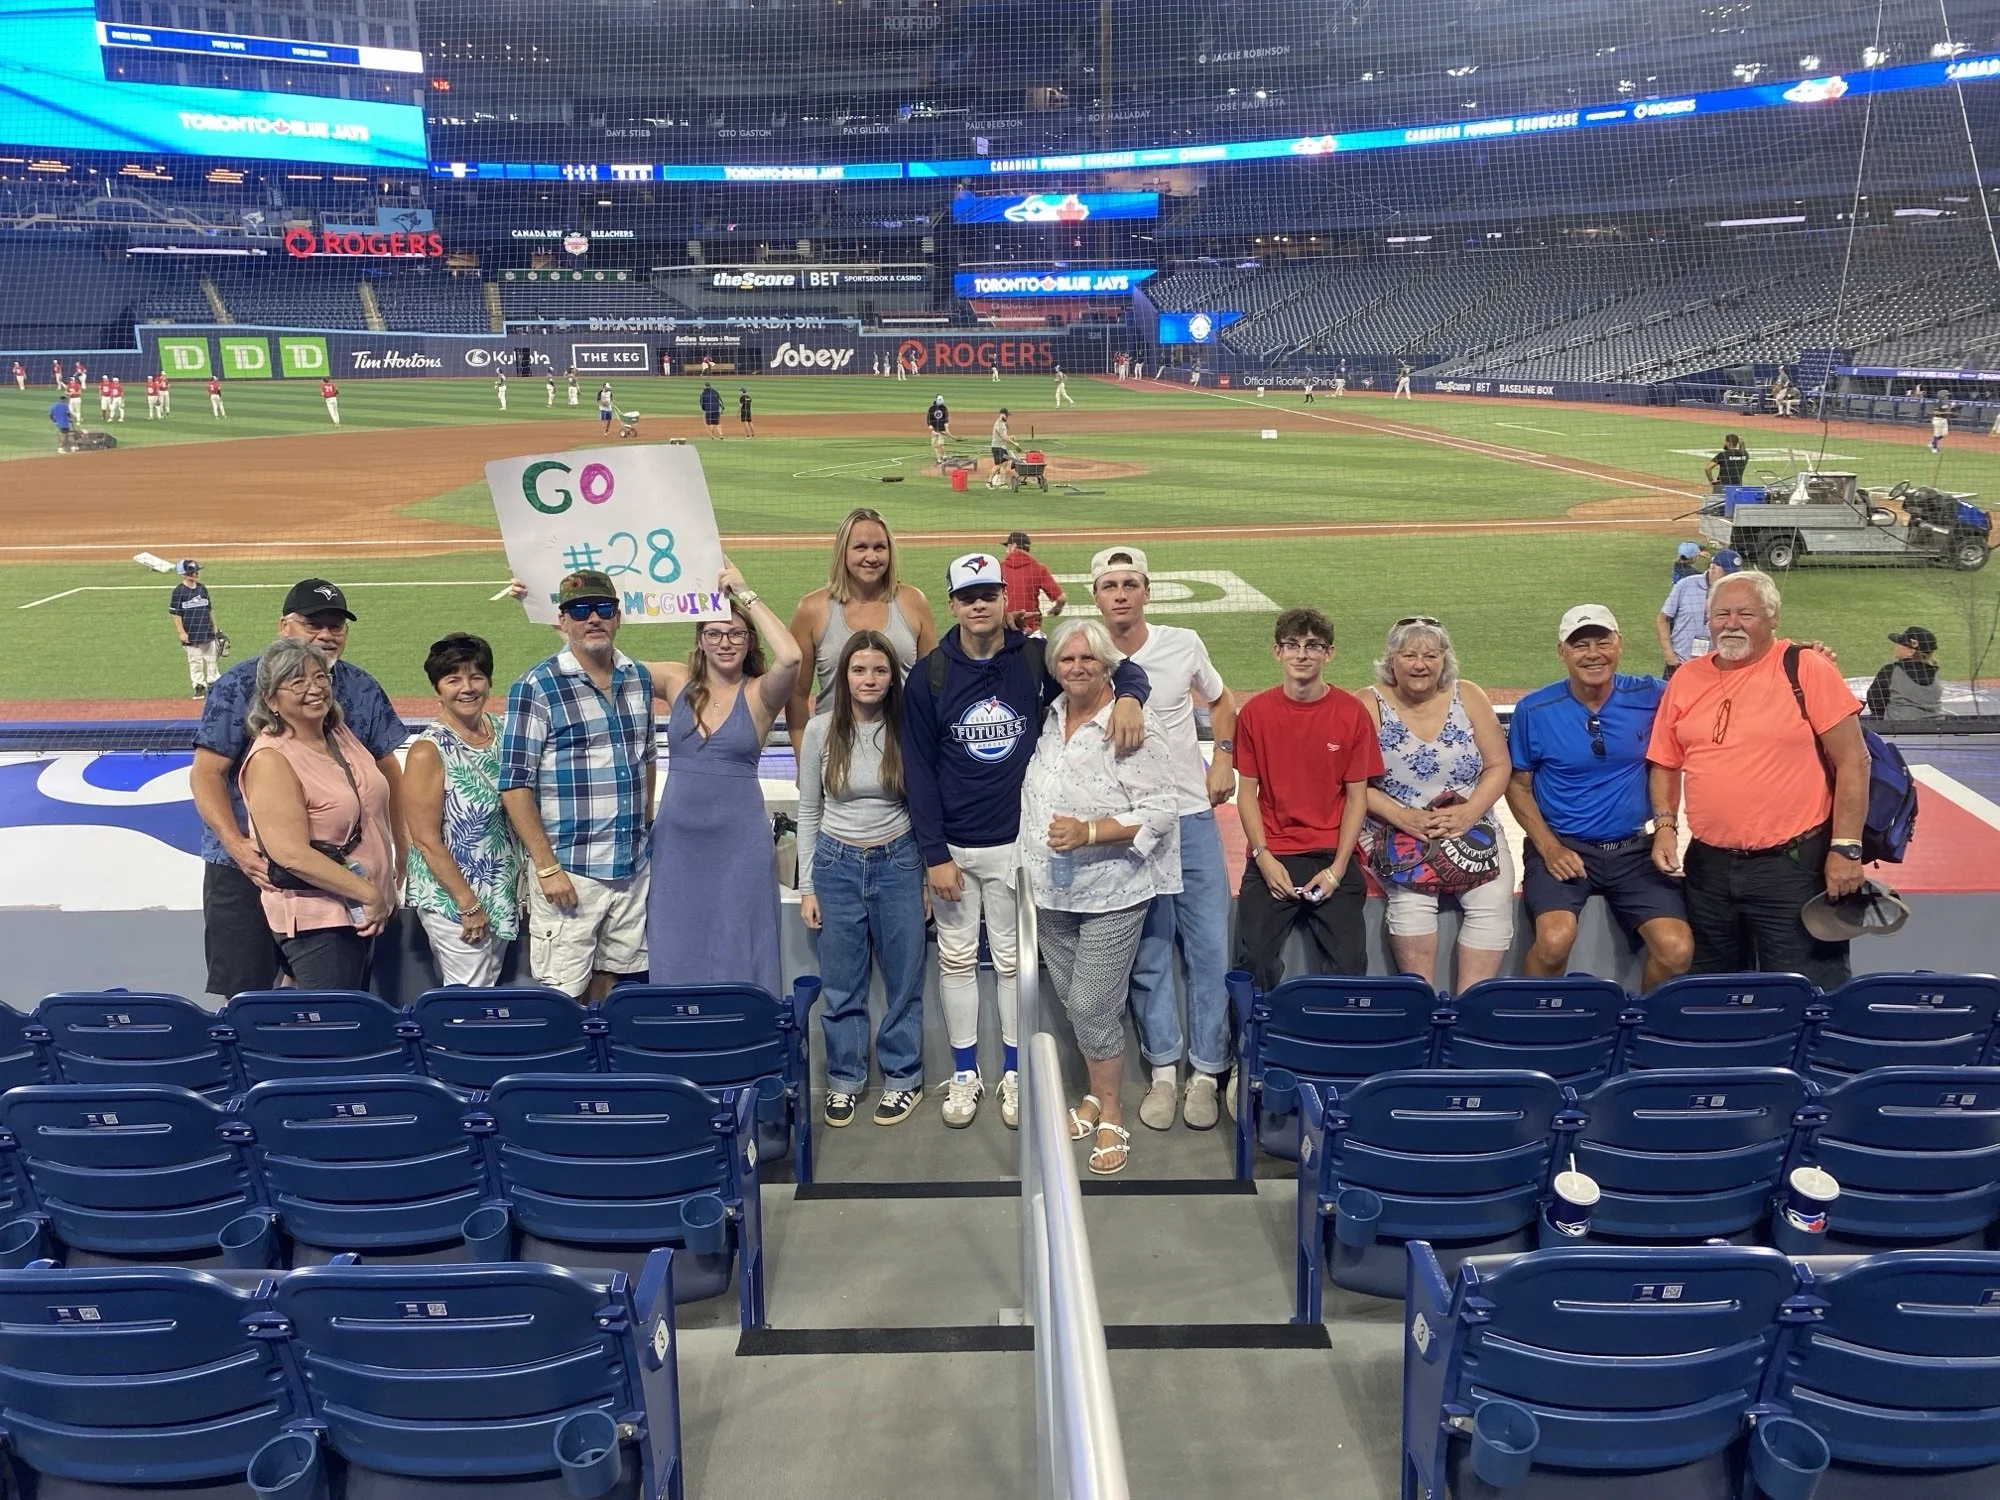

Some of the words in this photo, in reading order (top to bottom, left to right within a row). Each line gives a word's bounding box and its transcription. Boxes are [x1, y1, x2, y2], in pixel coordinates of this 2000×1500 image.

[1212, 51, 1241, 63] JACKIE
[1243, 45, 1290, 59] ROBINSON
[1241, 98, 1286, 110] BAUTISTA
[178, 111, 271, 134] TORONTO
[965, 121, 985, 130] PAUL
[987, 119, 1023, 129] BEESTON
[1088, 113, 1104, 122] ROY
[1107, 110, 1151, 121] HALLADAY
[1516, 112, 1579, 132] SHOWCASE
[606, 129, 627, 137] DAVE
[629, 129, 651, 137] STIEB
[718, 129, 737, 137] CITO
[739, 129, 772, 137] GASTON
[843, 127, 858, 136] PAT
[859, 125, 890, 135] GILLICK
[990, 158, 1038, 173] CANADIAN
[511, 230, 547, 238] CANADA
[547, 230, 562, 238] DRY
[591, 230, 634, 238] BLEACHERS
[323, 232, 443, 257] ROGERS
[713, 272, 796, 287] theScore
[810, 272, 840, 286] BET
[974, 277, 1040, 293] TORONTO
[1057, 276, 1091, 291] BLUE
[1093, 275, 1128, 290] JAYS
[164, 345, 205, 370] TD
[225, 344, 265, 370] TD
[285, 344, 323, 369] TD
[352, 350, 382, 369] Tim
[383, 349, 442, 368] Hortons
[581, 352, 609, 362] THE
[613, 352, 640, 362] KEG
[770, 342, 854, 371] Sobeys
[935, 342, 1054, 368] ROGERS
[1243, 376, 1275, 387] Official
[1435, 381, 1471, 392] theScore
[1476, 382, 1492, 393] BET
[1499, 384, 1536, 395] BASELINE
[1537, 385, 1555, 396] BOX
[522, 460, 615, 514] GO
[563, 528, 682, 584] #28
[623, 591, 723, 616] MCGUIRK
[970, 714, 1008, 723] CANADIAN
[957, 721, 1022, 740] FUTURES
